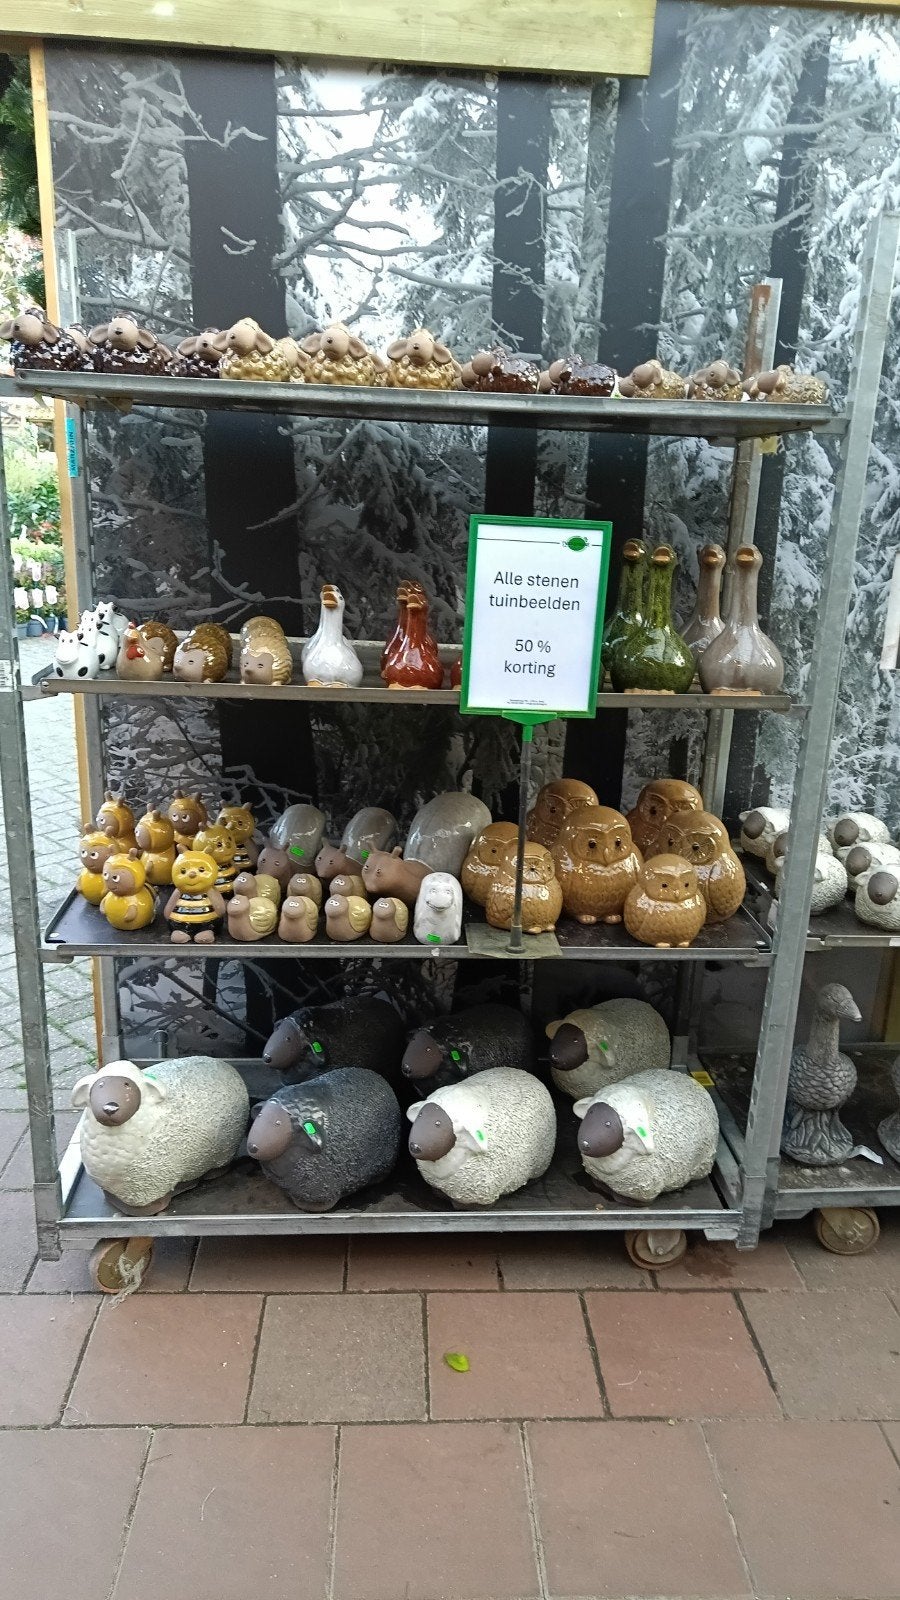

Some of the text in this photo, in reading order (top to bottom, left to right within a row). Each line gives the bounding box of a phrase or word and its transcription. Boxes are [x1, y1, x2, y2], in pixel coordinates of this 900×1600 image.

[493, 571, 579, 588] Alle stenen
[489, 594, 580, 611] tuinbeelden
[514, 639, 551, 653] 50 %
[504, 660, 555, 677] korting
